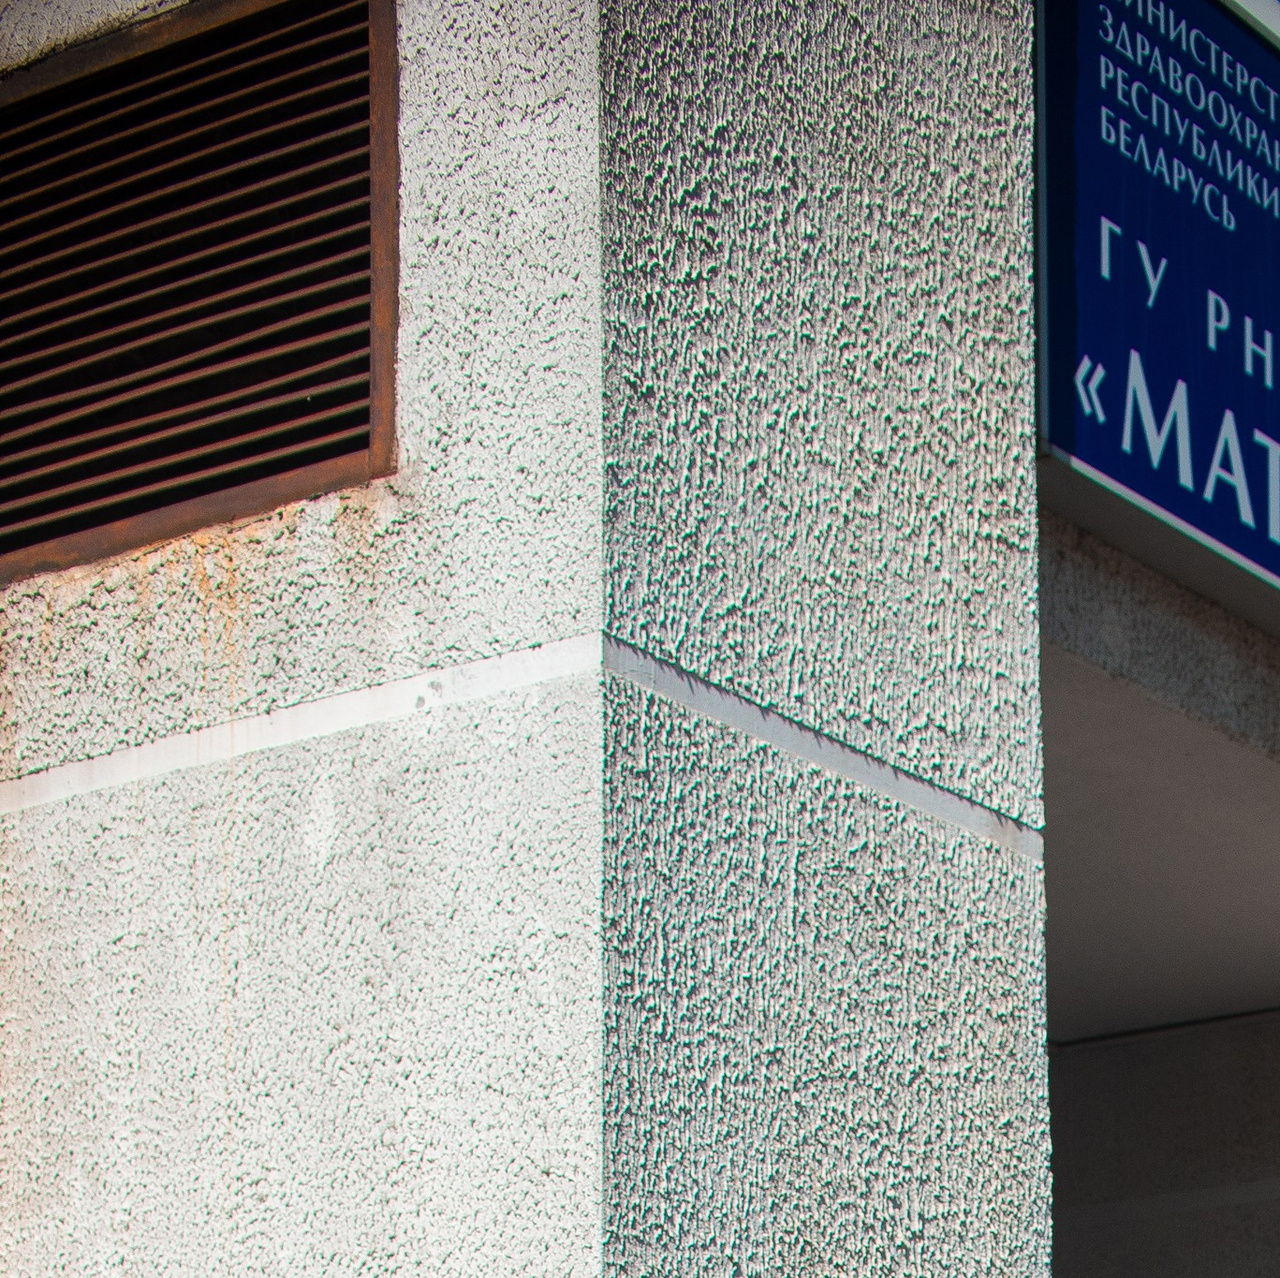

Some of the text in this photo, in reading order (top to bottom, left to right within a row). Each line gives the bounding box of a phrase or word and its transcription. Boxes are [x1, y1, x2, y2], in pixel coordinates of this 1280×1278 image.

[1100, 54, 1280, 218] РЕСПУБЛИКИ
[1100, 105, 1236, 231] БЕЛАРУСЬ
[1100, 215, 1168, 308] ГУ
